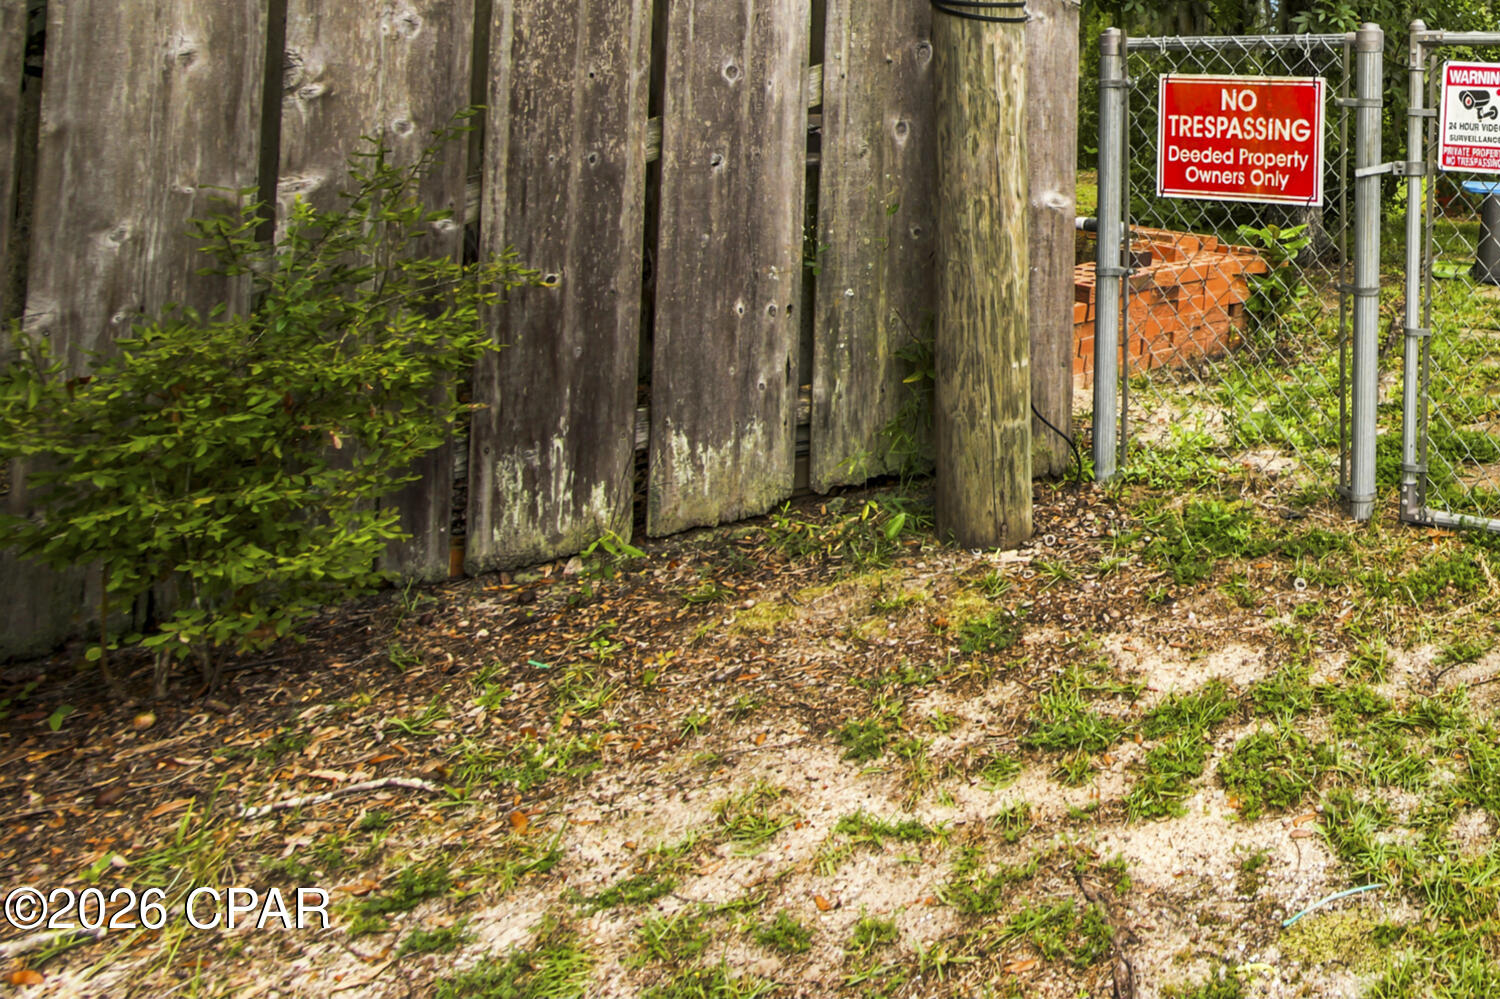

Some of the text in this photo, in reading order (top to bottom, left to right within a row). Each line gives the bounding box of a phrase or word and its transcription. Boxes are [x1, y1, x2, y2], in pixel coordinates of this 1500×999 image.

[1221, 88, 1257, 112] NO
[1168, 115, 1311, 142] TRESPASSING
[1448, 122, 1457, 130] 24
[1459, 122, 1480, 131] HOUR
[1168, 145, 1309, 172] Deeded Property
[1444, 146, 1470, 156] PRIVATE
[1446, 155, 1455, 165] NO
[1185, 166, 1290, 191] Owners Only
